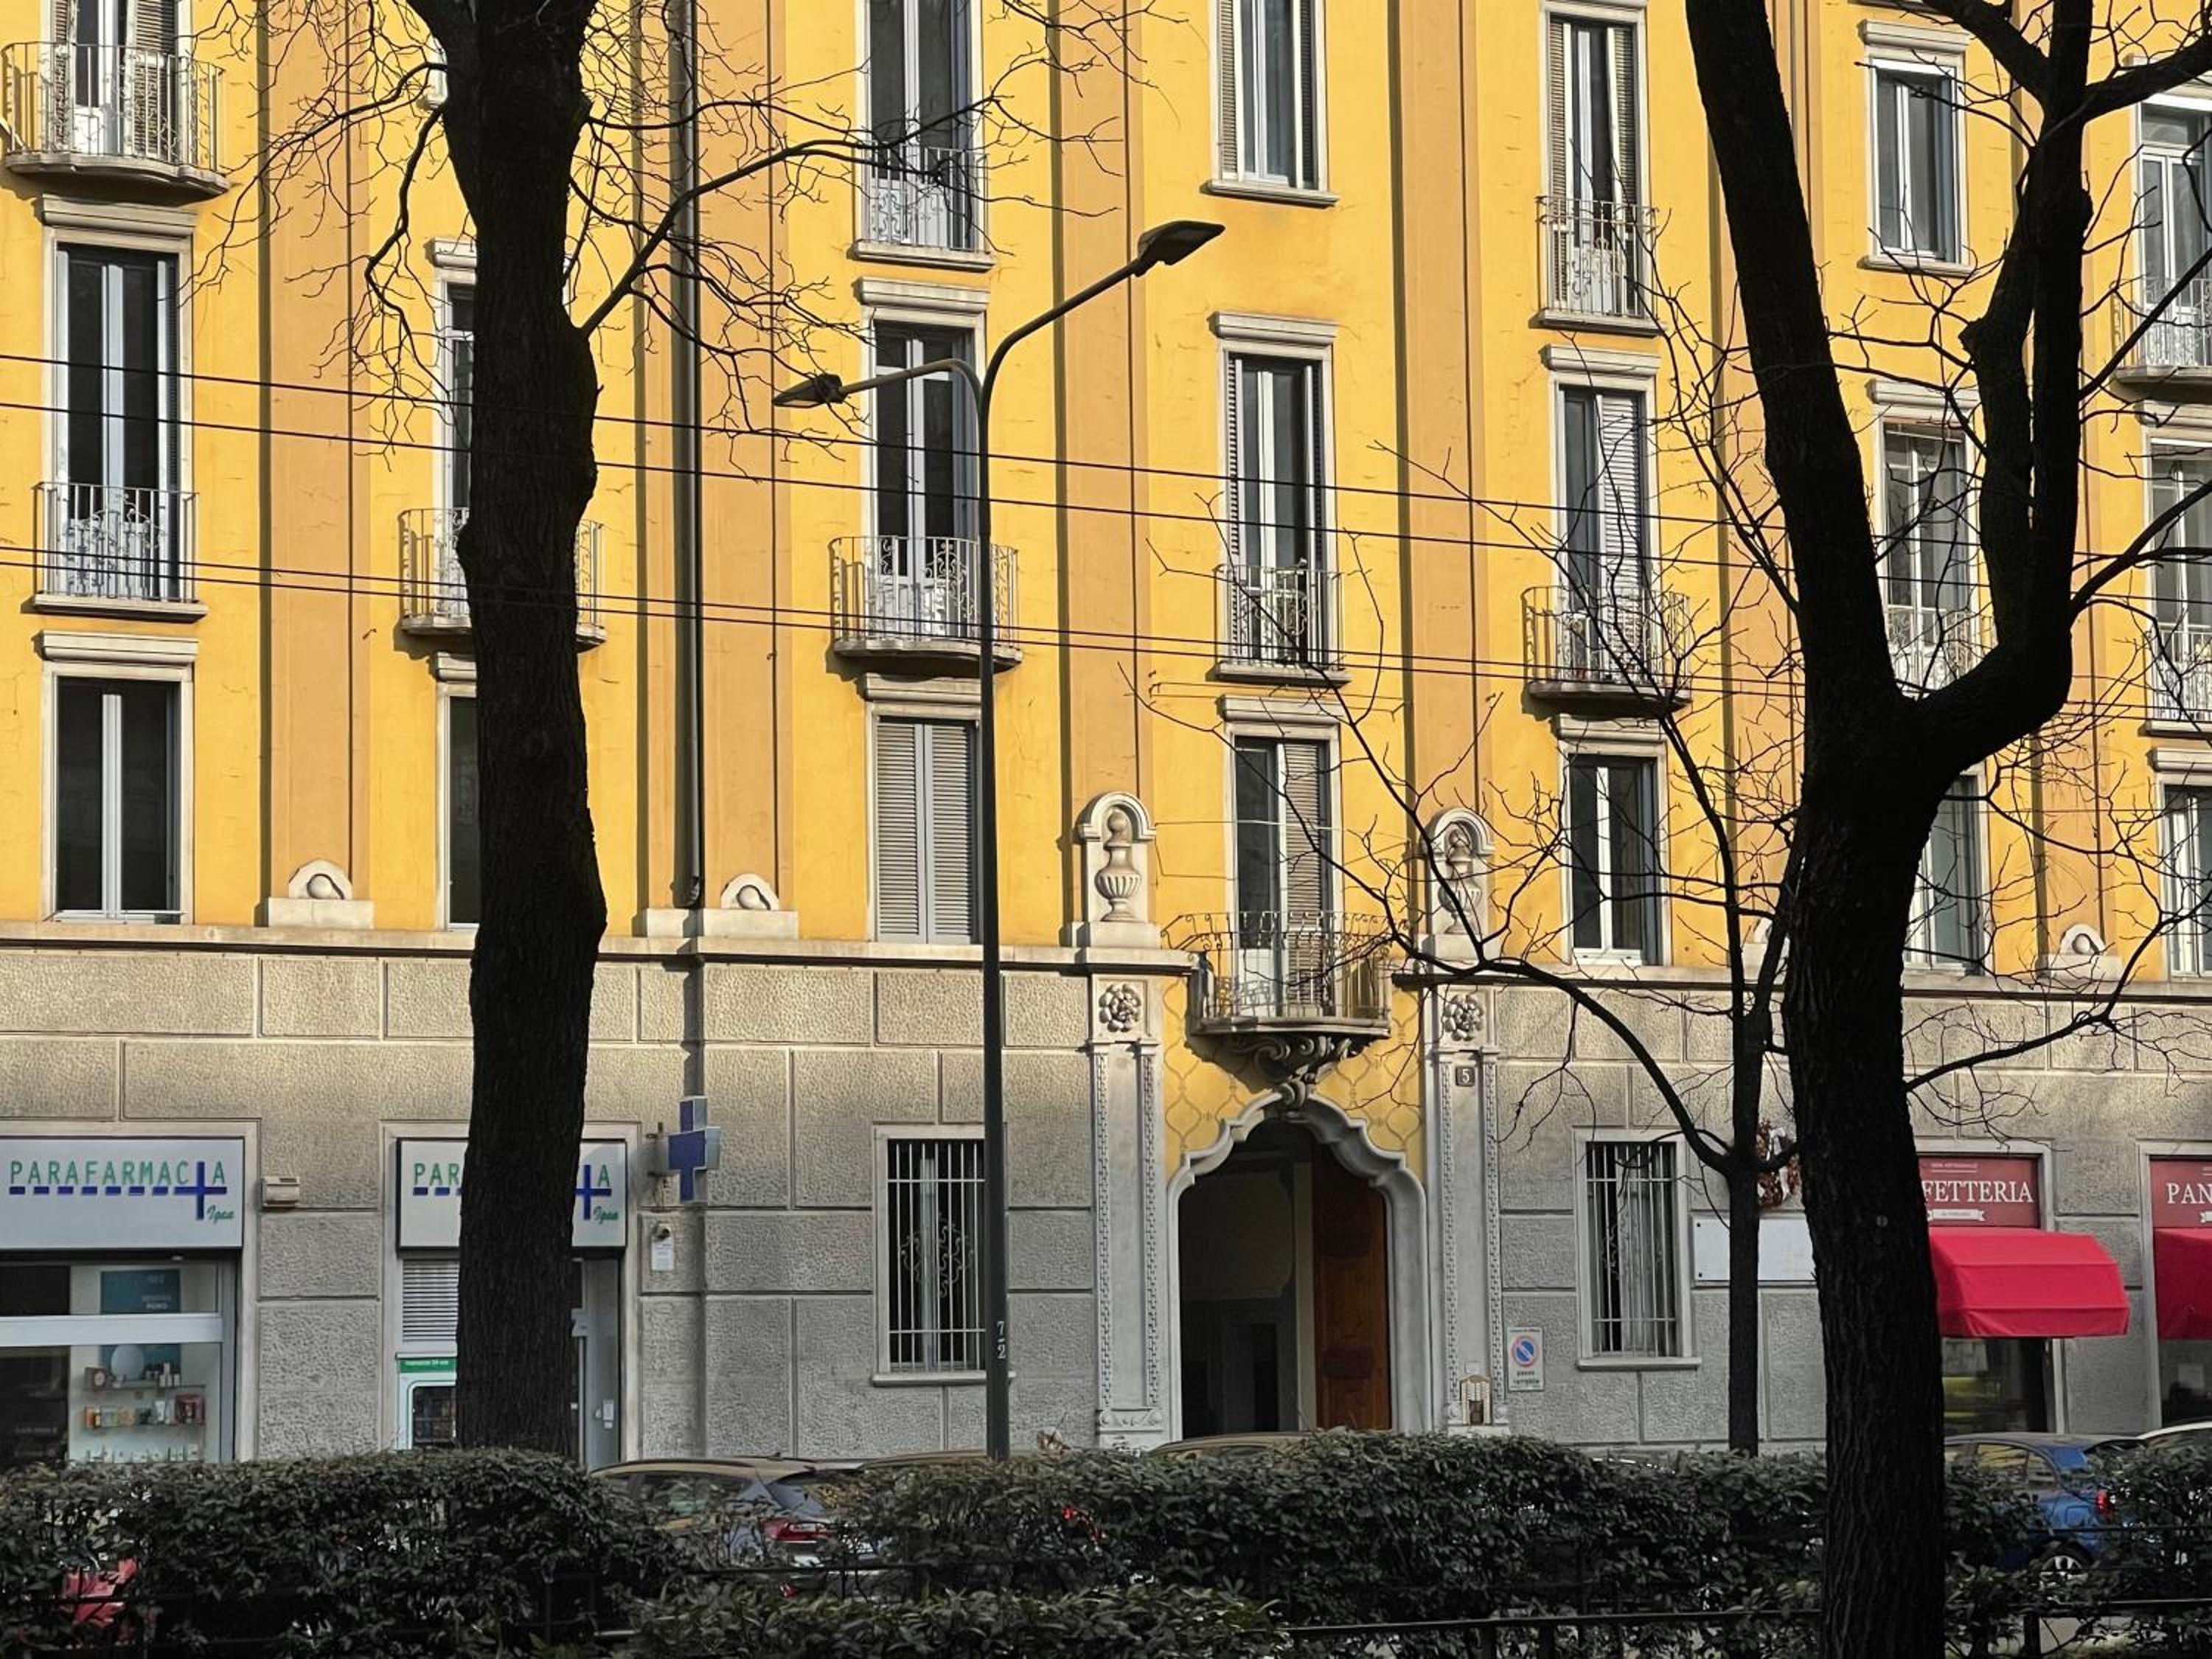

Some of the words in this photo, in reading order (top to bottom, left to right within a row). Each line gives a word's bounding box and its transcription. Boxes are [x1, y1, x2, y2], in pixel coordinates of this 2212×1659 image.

[1462, 1068, 1470, 1083] 5
[1921, 1180, 2034, 1203] FETTERIA
[2166, 1182, 2212, 1204] PAN
